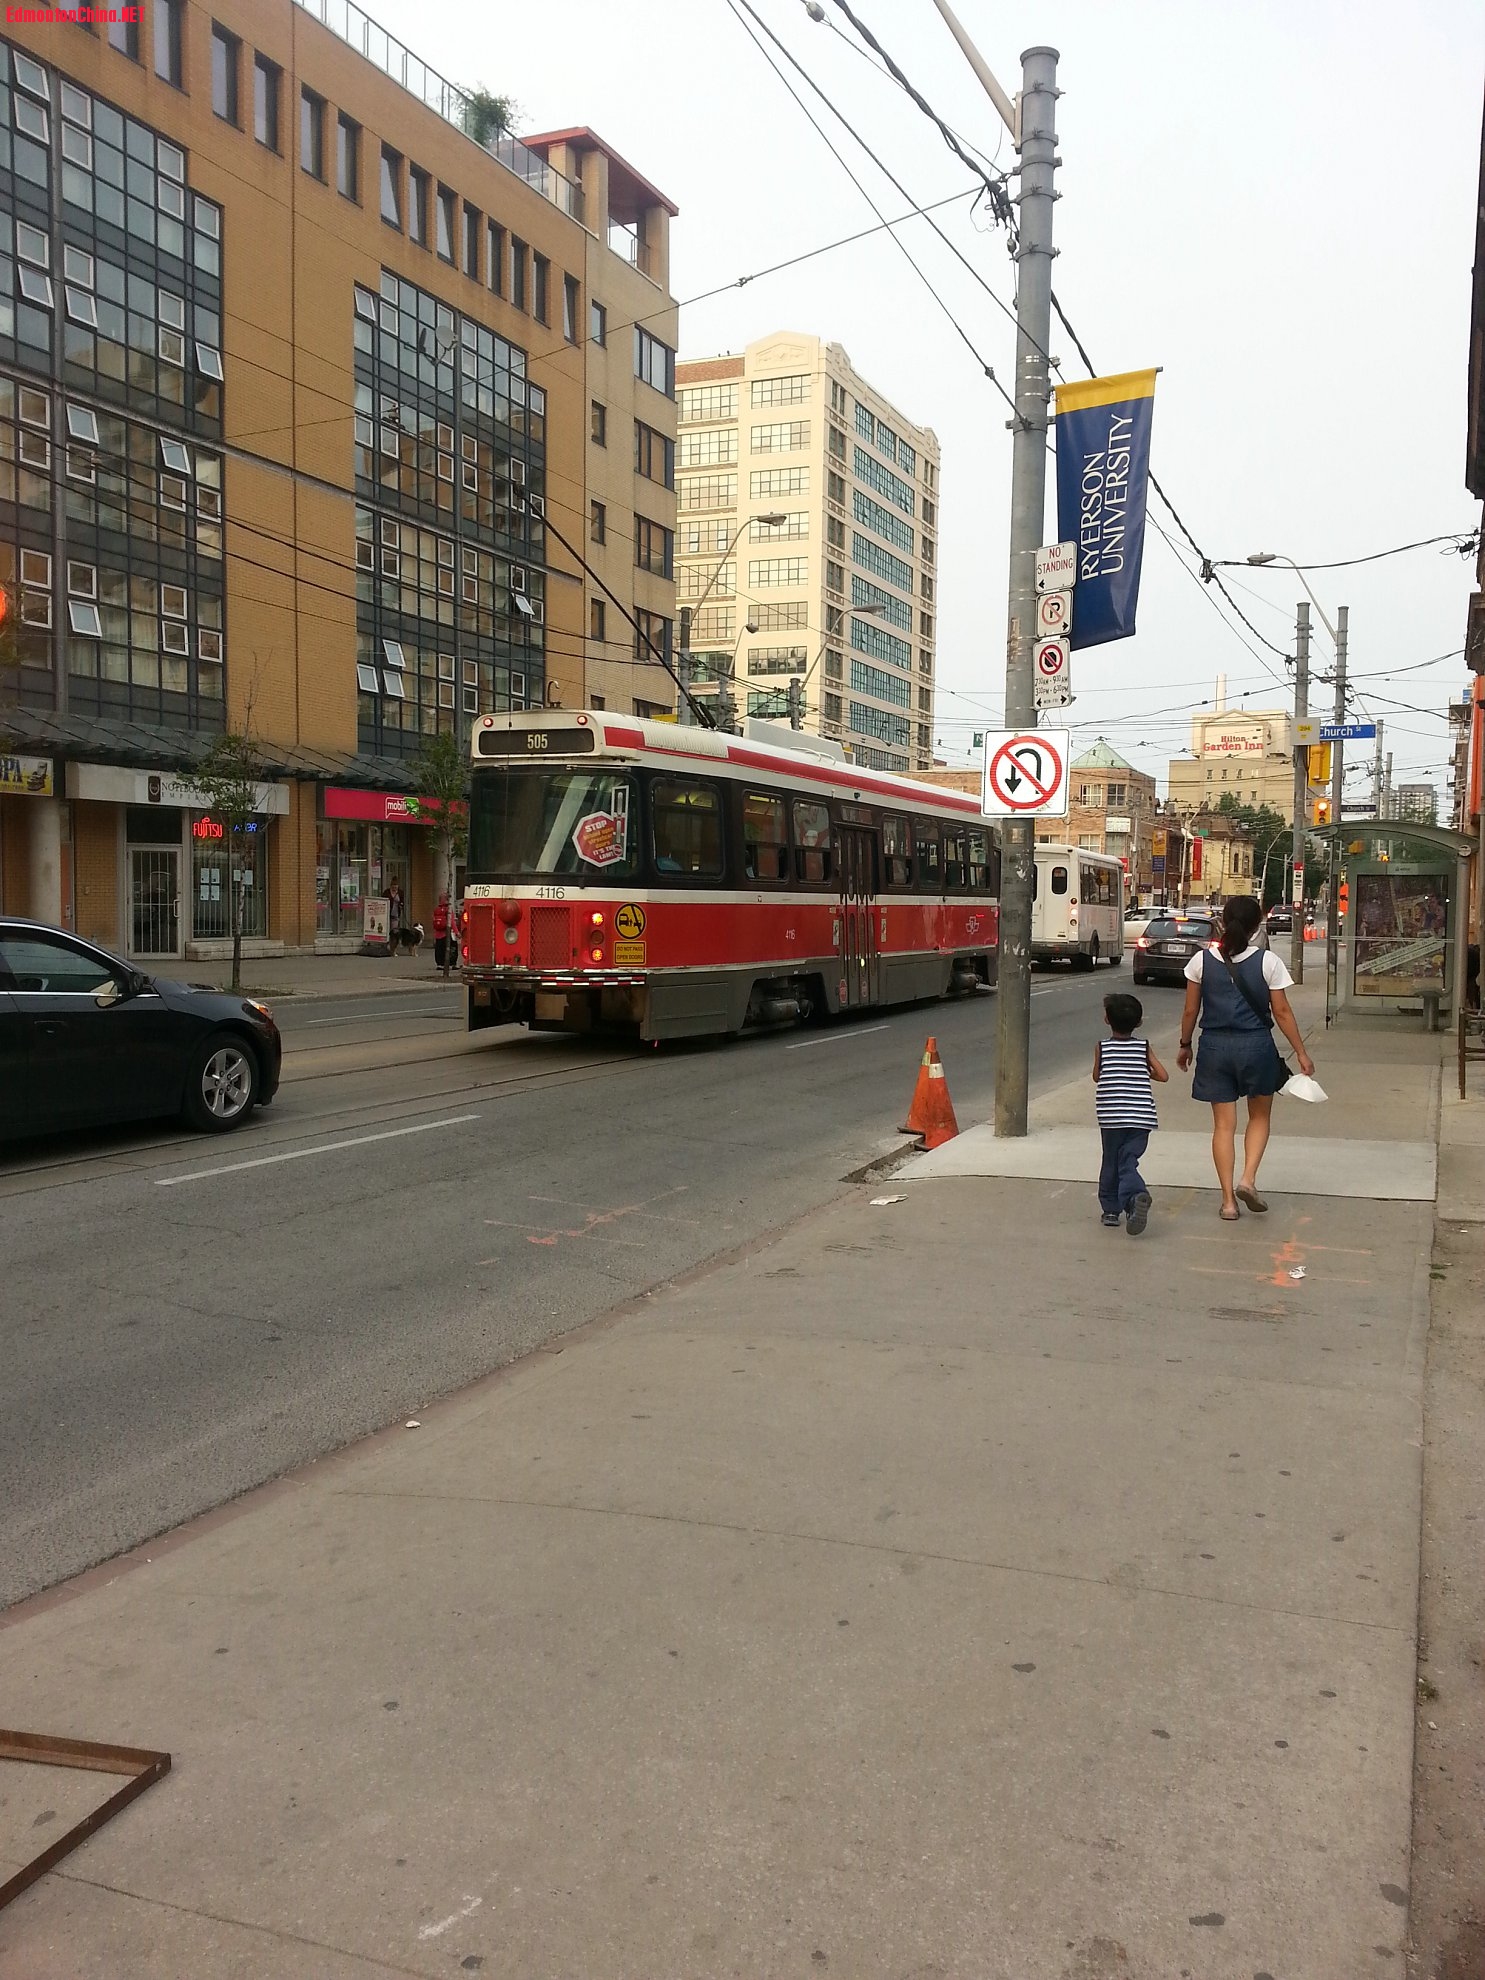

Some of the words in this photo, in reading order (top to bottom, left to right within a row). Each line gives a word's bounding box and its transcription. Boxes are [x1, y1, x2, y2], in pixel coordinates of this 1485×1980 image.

[1101, 414, 1133, 575] UNIVERSITY
[1081, 452, 1105, 580] RYERSON
[1049, 547, 1061, 559] NO
[1038, 558, 1073, 575] STANDING
[1320, 727, 1353, 737] Church
[527, 734, 548, 749] 505
[1203, 742, 1242, 751] Garden
[1245, 741, 1264, 750] Inn
[0, 757, 23, 782] PA
[161, 781, 203, 793] NOTEBOO
[193, 817, 223, 838] FUJITSU
[584, 820, 607, 833] STOP
[473, 885, 490, 897] 4116
[536, 887, 565, 899] 4116
[785, 929, 795, 940] 4116
